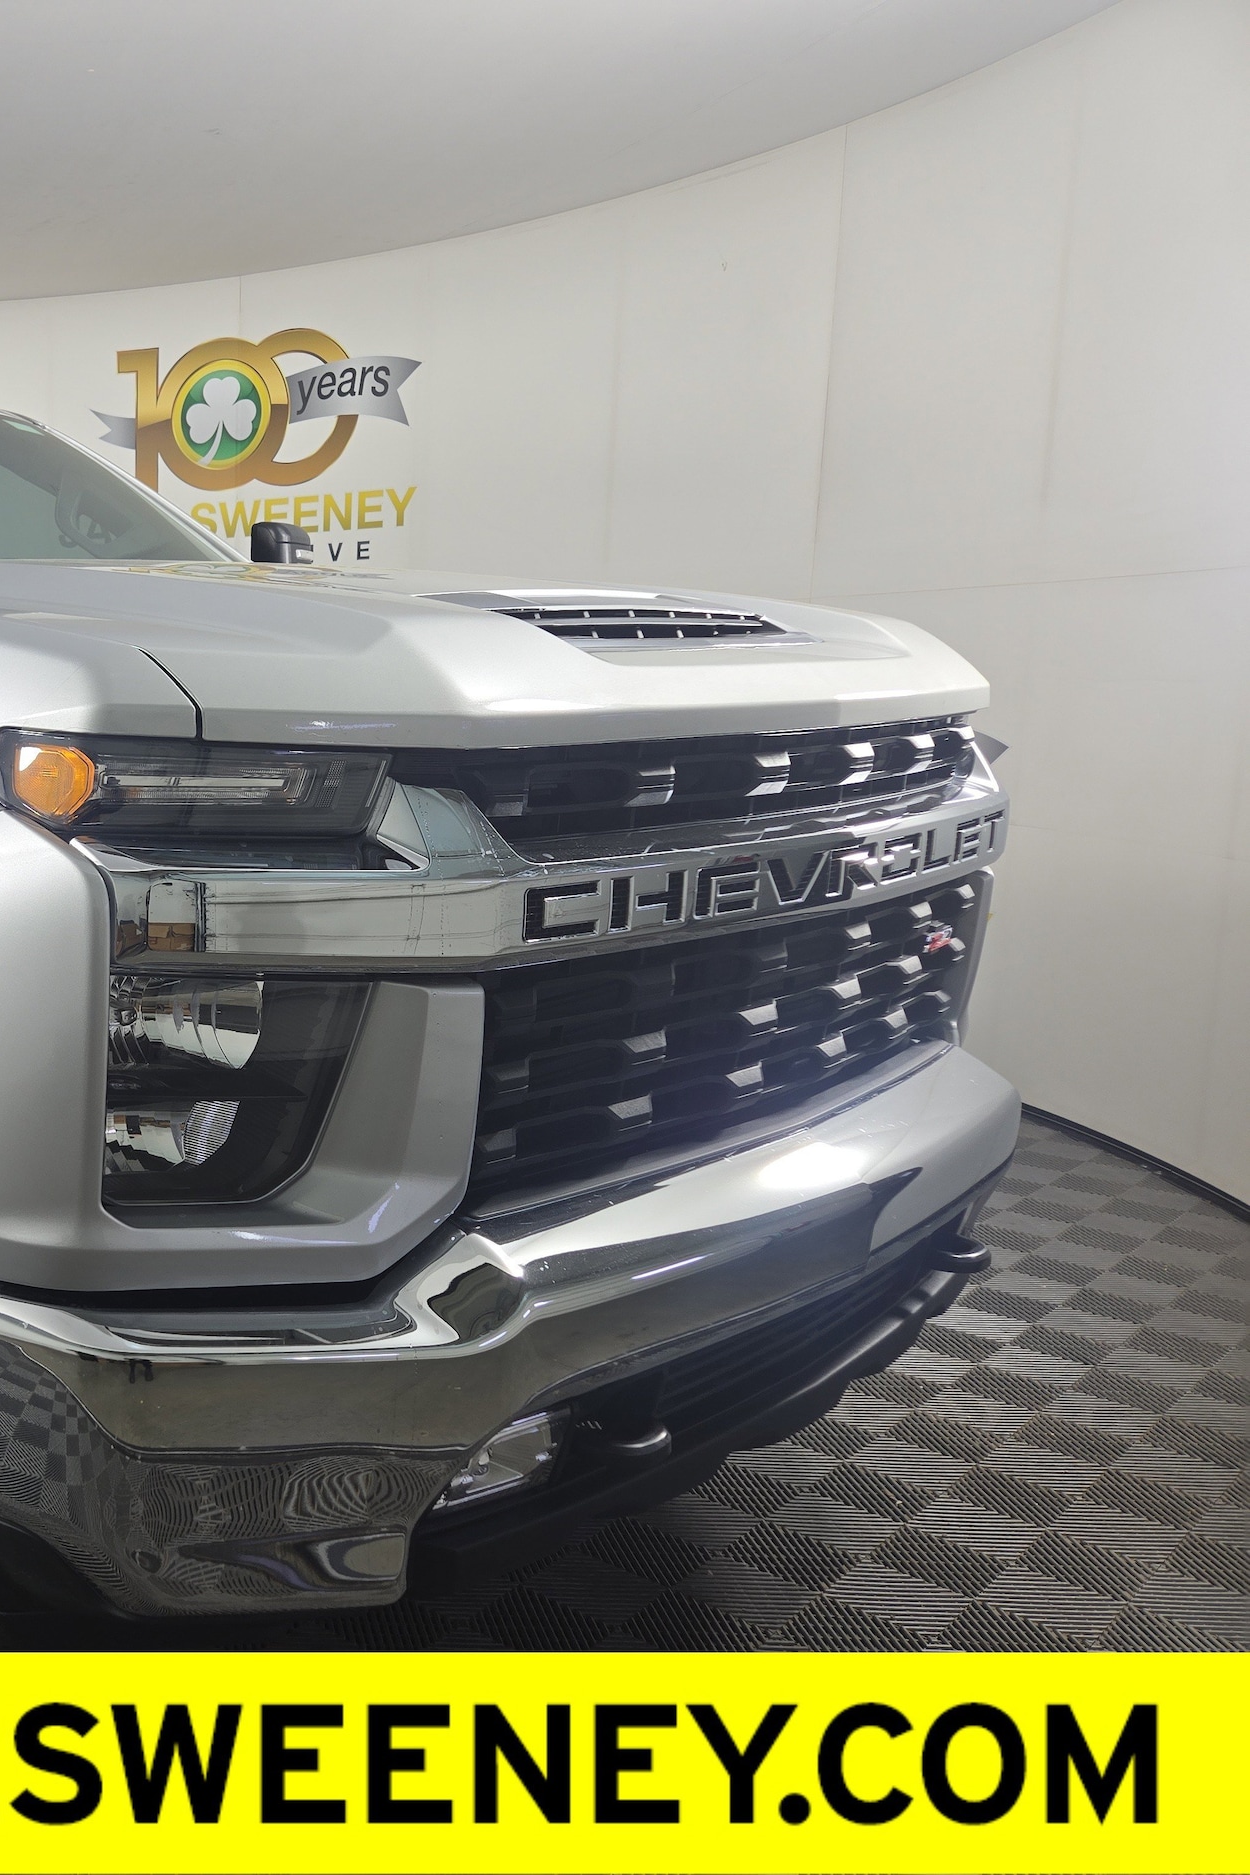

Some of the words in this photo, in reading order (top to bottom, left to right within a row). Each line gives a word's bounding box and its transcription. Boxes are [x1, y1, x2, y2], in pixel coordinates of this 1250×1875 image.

[117, 327, 359, 491] 100
[297, 361, 390, 415] years
[191, 486, 417, 539] SWEENEY
[522, 809, 1005, 943] CHEVROLET
